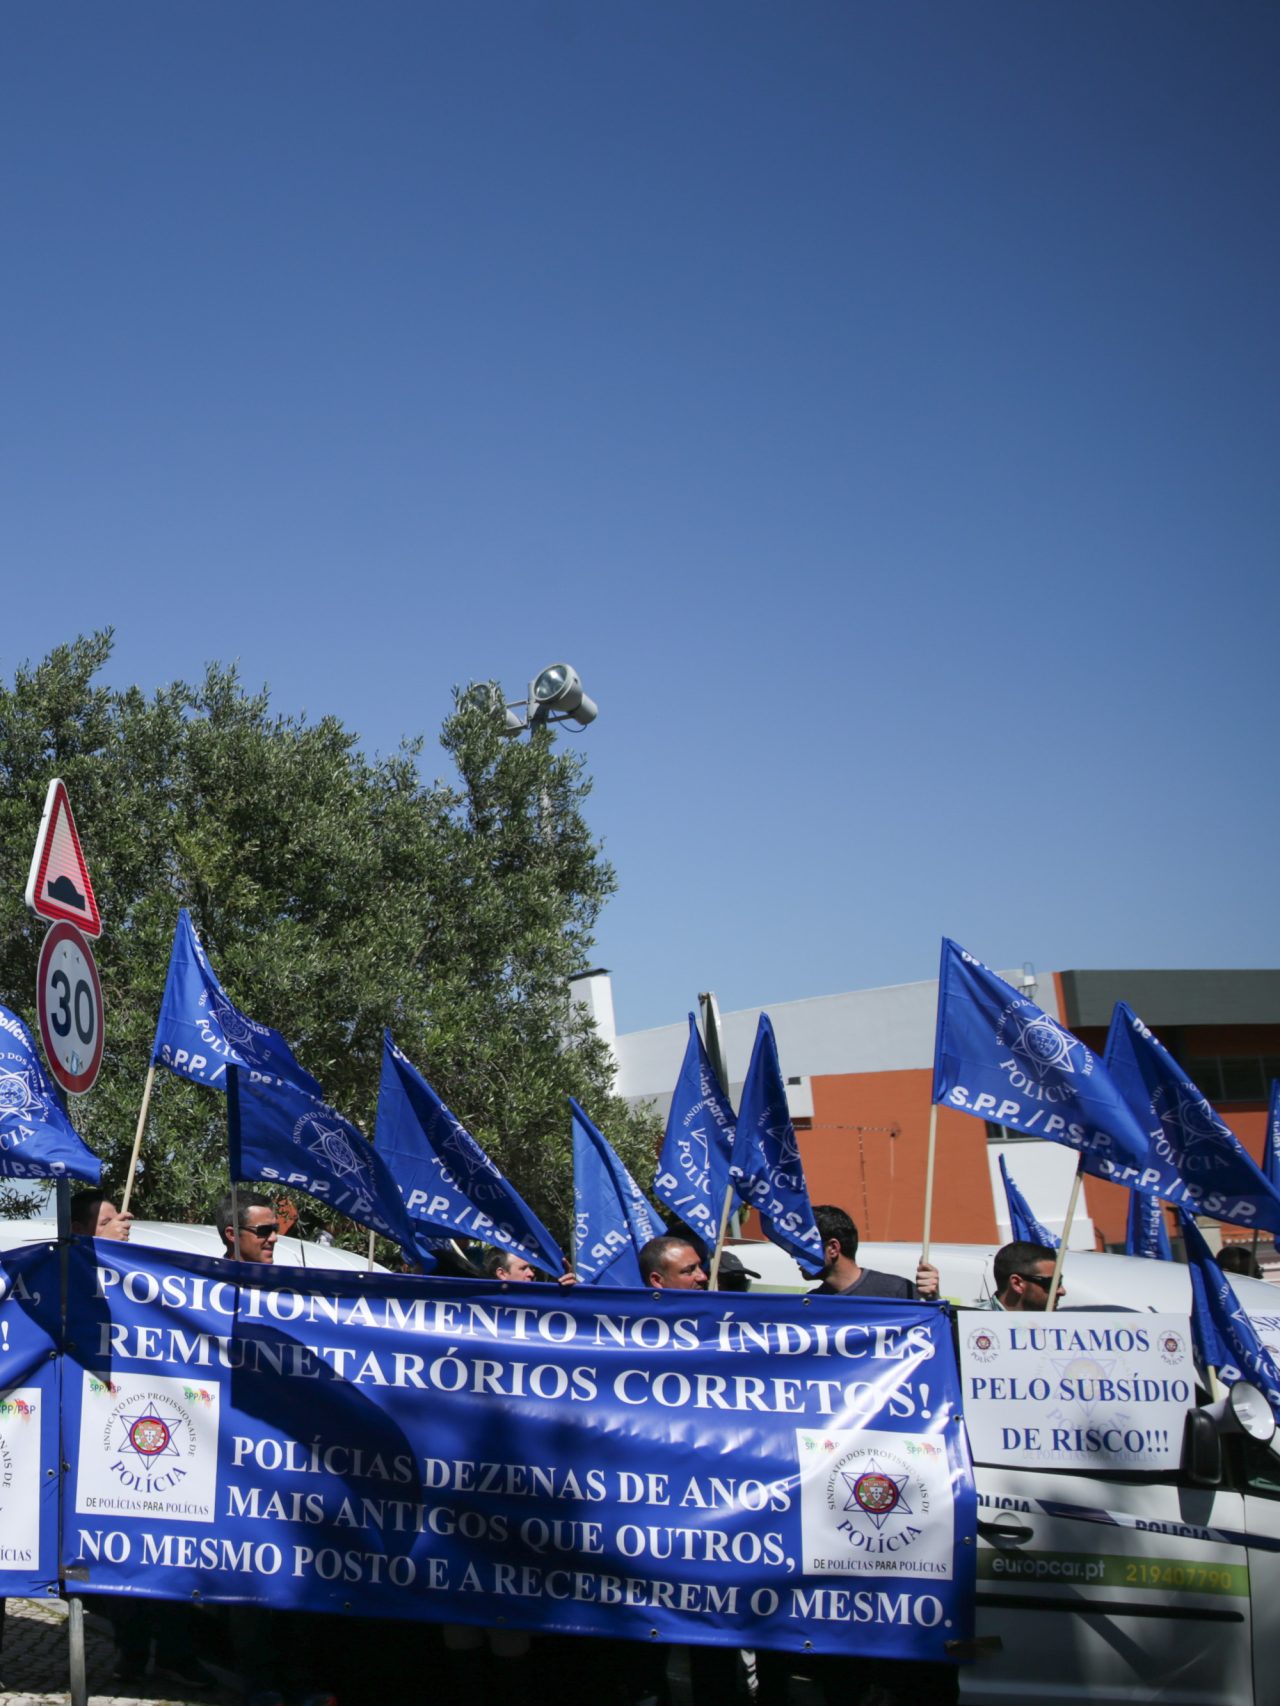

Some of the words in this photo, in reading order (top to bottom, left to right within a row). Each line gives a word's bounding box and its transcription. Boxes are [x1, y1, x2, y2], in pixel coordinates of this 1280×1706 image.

[50, 969, 95, 1046] 30
[7, 1051, 27, 1066] DOS
[161, 1044, 207, 1077] S.P.P.
[249, 1070, 272, 1085] De
[998, 1058, 1079, 1102] POLÍCIA
[703, 1097, 728, 1125] para
[948, 1085, 1021, 1124] S.P.P.
[1043, 1113, 1112, 1154] P.S.P.
[293, 1112, 318, 1145] SINDICATO
[10, 1160, 72, 1178] P.S.P.
[260, 1166, 331, 1198] S.P.P.
[677, 1139, 711, 1196] POLÍC
[1181, 1182, 1257, 1224] P.S.P.
[398, 1184, 450, 1220] .P.P.
[471, 1210, 540, 1259] P.S.P.
[686, 1202, 717, 1244] P.S.
[93, 1266, 577, 1343] POSICIONAMENTO
[593, 1313, 700, 1351] NOS
[717, 1311, 936, 1360] ÍNDICES
[1008, 1328, 1150, 1352] LUTAMOS
[95, 1322, 597, 1401] REMUNETARÓRIOS
[613, 1369, 931, 1420] CORRETOS!
[970, 1377, 1051, 1401] PELO
[1059, 1372, 1190, 1402] SUBSÍDIO
[104, 1402, 126, 1452] SINDICATO
[126, 1392, 146, 1405] DOS
[147, 1392, 197, 1443] PROFISSIONAIS
[187, 1445, 196, 1457] DE
[1001, 1427, 1042, 1451] DE
[1051, 1428, 1169, 1453] RISCO!!!
[2, 1472, 13, 1488] DE
[109, 1460, 188, 1493] POLÍCIA
[231, 1429, 414, 1484] POLÍCIAS
[423, 1457, 607, 1501] DEZENAS
[618, 1470, 670, 1506] DE
[679, 1475, 792, 1513] ANOS
[827, 1458, 846, 1511] SINDICATO
[846, 1449, 866, 1462] DOS
[867, 1448, 929, 1499] PROFISSIOAIS
[86, 1497, 97, 1508] DE
[98, 1496, 142, 1510] POLÍCIAS
[143, 1500, 164, 1512] PARA
[166, 1500, 209, 1515] POLÍCIAS
[226, 1485, 325, 1523] MAIS
[332, 1497, 509, 1542] ANTIGOS
[520, 1516, 604, 1556] QUE
[615, 1524, 796, 1573] OUTROS,
[836, 1519, 922, 1554] POLÍCIA
[76, 1529, 131, 1564] NO
[141, 1532, 282, 1576] MESMO
[292, 1545, 417, 1586] POSTO
[427, 1557, 451, 1590] E
[458, 1562, 484, 1595] A
[493, 1562, 740, 1614] RECEBEREM
[749, 1587, 779, 1616] O
[788, 1588, 953, 1629] MESMO.
[813, 1558, 826, 1569] DE
[827, 1557, 875, 1571] POLÍCIAS
[875, 1560, 898, 1571] PARA
[899, 1559, 947, 1573] POLÍCIAS
[992, 1557, 1106, 1580] europcar.pt
[1125, 1564, 1233, 1590] 219407790
